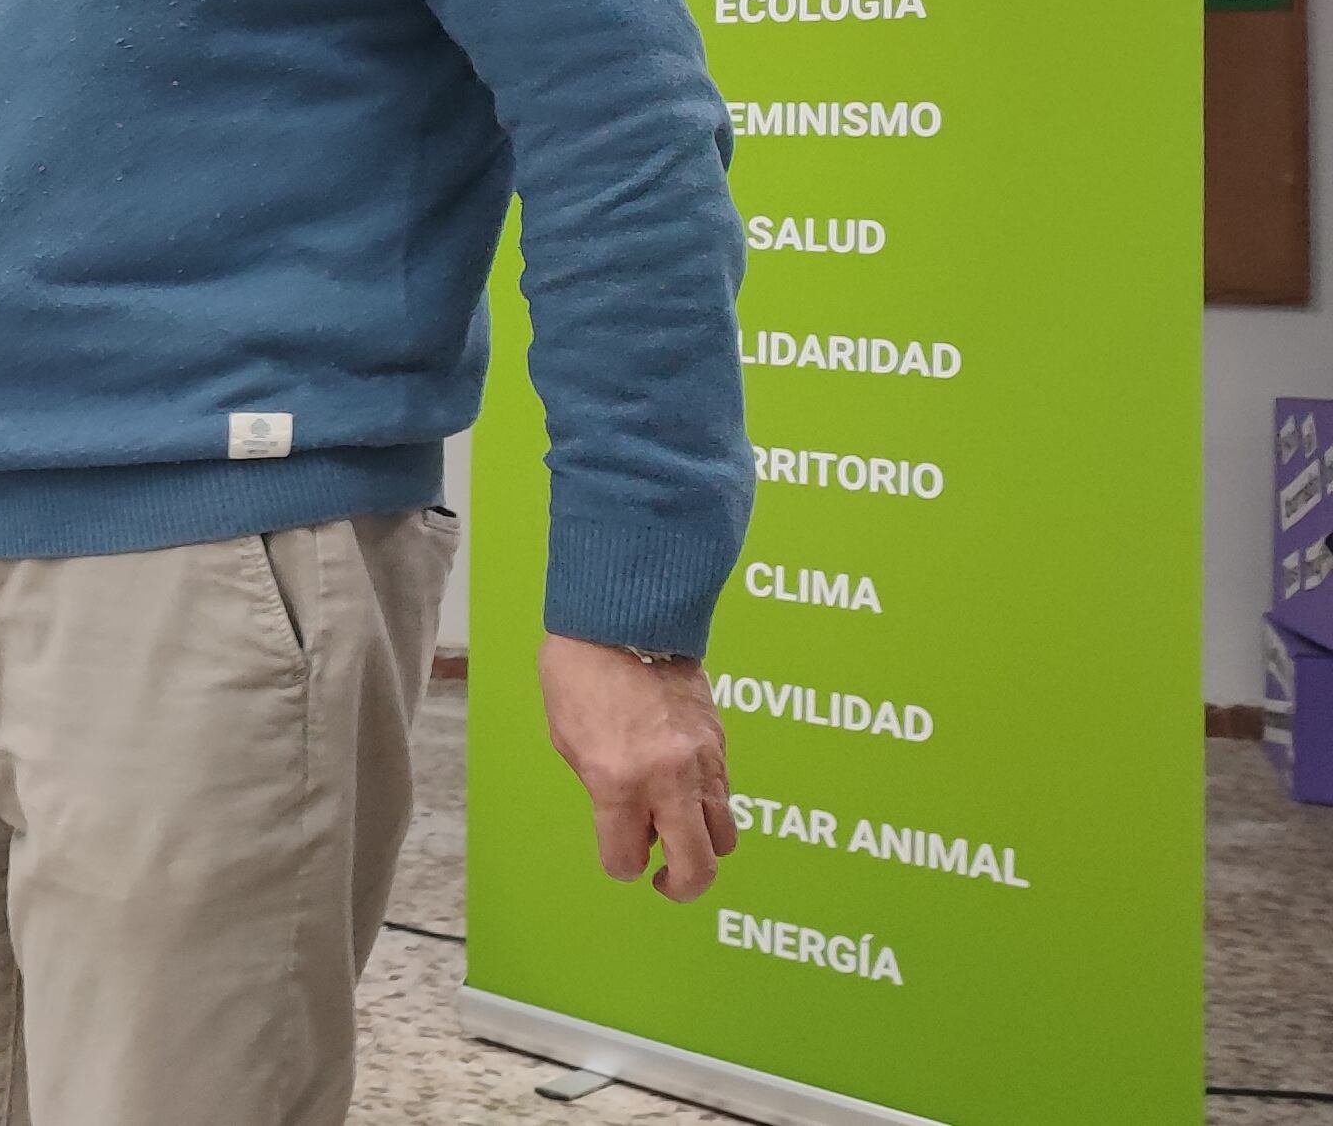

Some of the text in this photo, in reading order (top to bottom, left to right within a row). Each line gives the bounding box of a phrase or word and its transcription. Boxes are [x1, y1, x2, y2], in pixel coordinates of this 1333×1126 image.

[725, 101, 943, 138] EMINISMO
[747, 215, 886, 255] SALUD
[737, 330, 963, 379] LIDARIDAD
[750, 445, 945, 499] RRITORIO
[744, 561, 883, 615] CLIMA
[704, 670, 934, 743] MOVILIDAD
[848, 818, 1031, 889] ANIMAL
[717, 908, 903, 986] ENERGÍA
